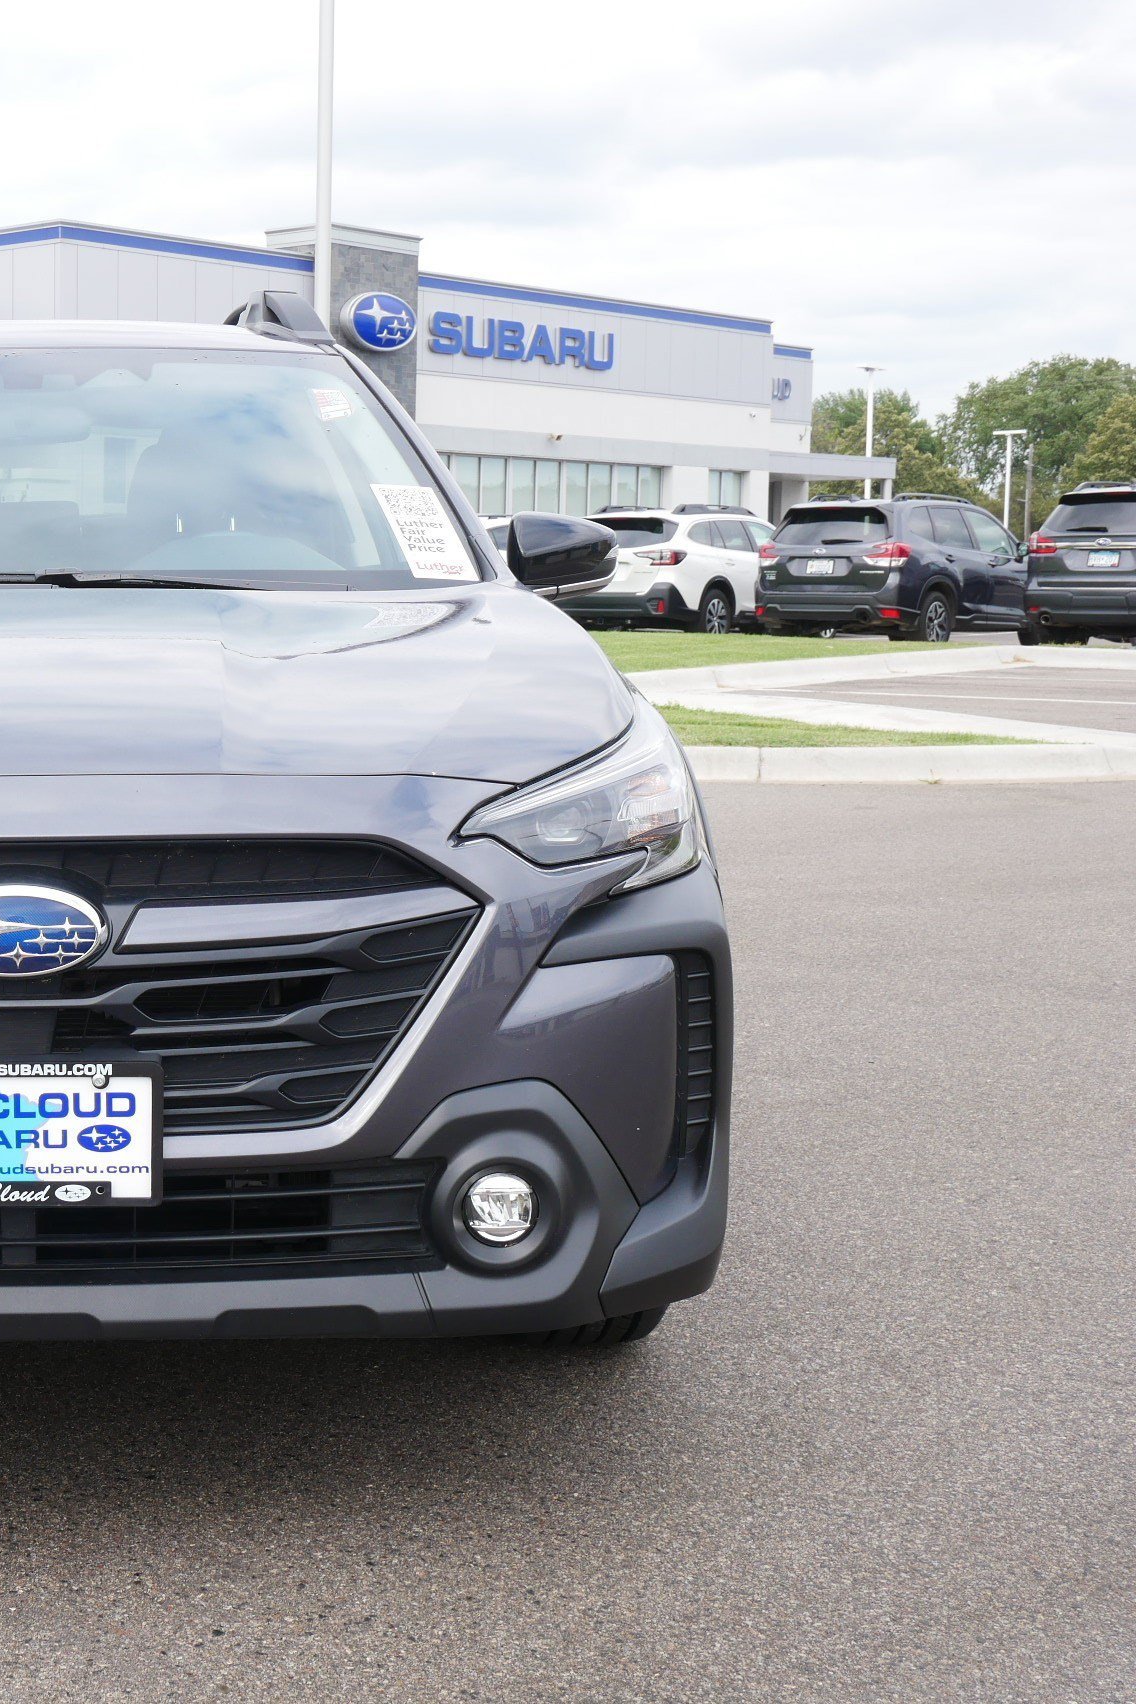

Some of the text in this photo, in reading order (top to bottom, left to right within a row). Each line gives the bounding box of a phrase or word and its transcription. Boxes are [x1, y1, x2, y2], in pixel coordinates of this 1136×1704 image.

[429, 311, 614, 370] SUBARU
[396, 519, 443, 528] Luther
[400, 527, 426, 535] Fair
[403, 535, 445, 544] Value
[408, 543, 445, 552] Price
[416, 561, 463, 571] Luther
